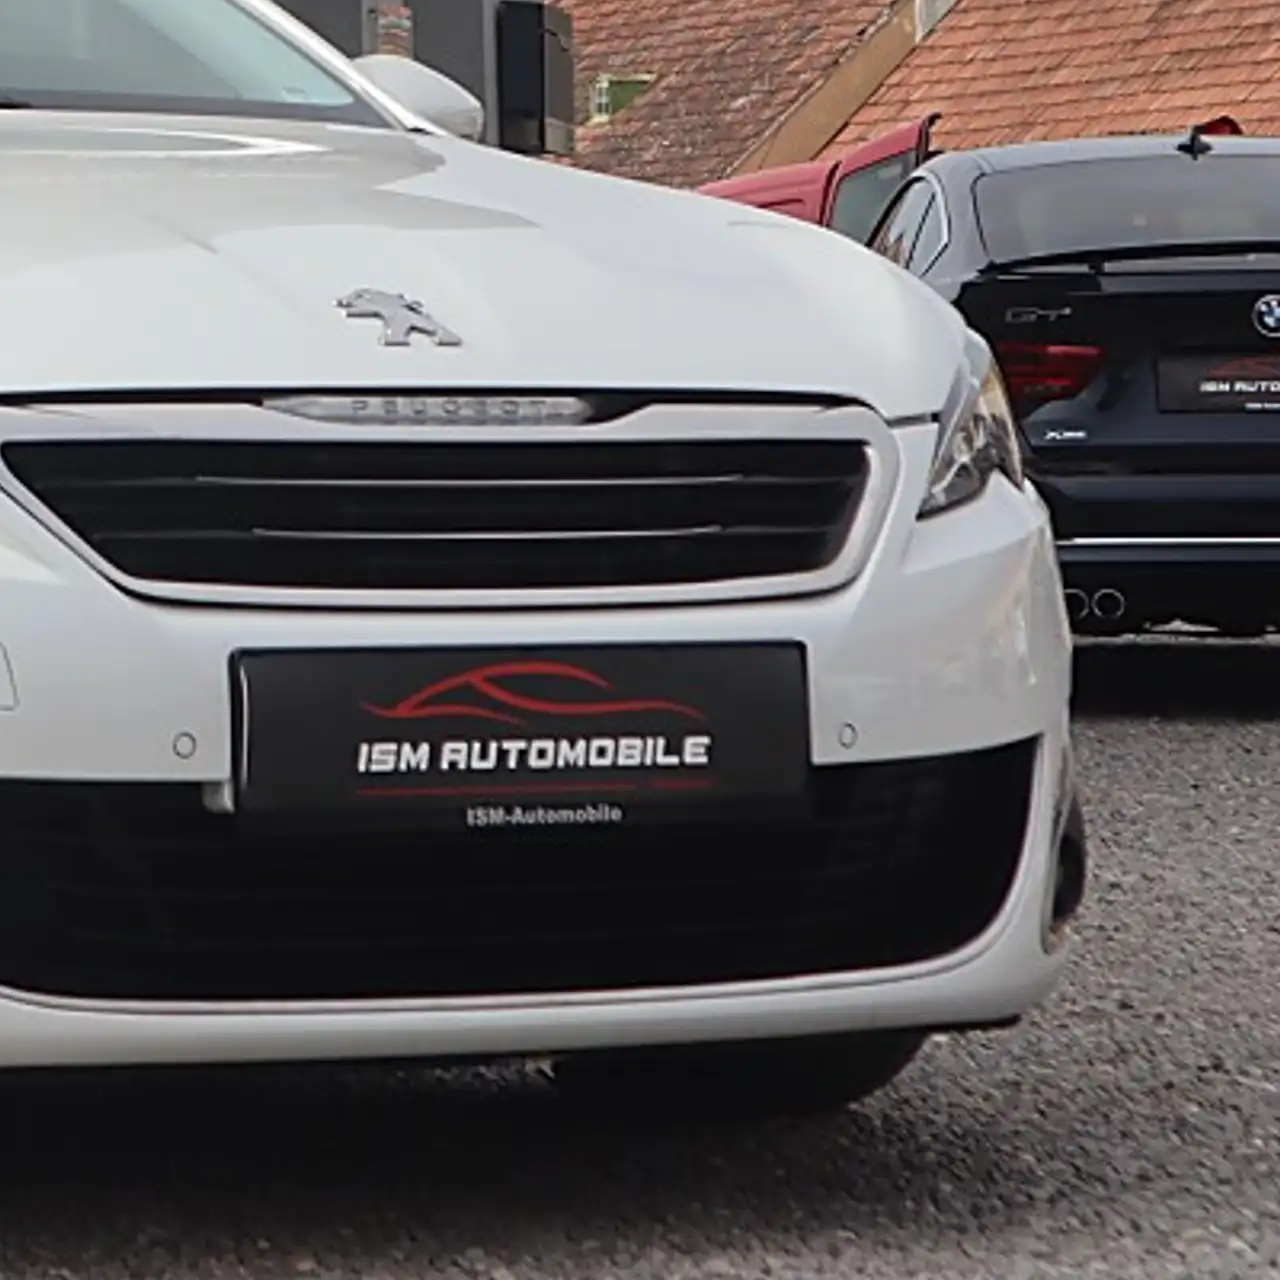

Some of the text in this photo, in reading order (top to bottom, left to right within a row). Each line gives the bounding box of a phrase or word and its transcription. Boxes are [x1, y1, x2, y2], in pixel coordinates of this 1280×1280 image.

[357, 735, 712, 773] ISM AUTOMOBILE
[466, 804, 623, 827] ISM-Automobile
